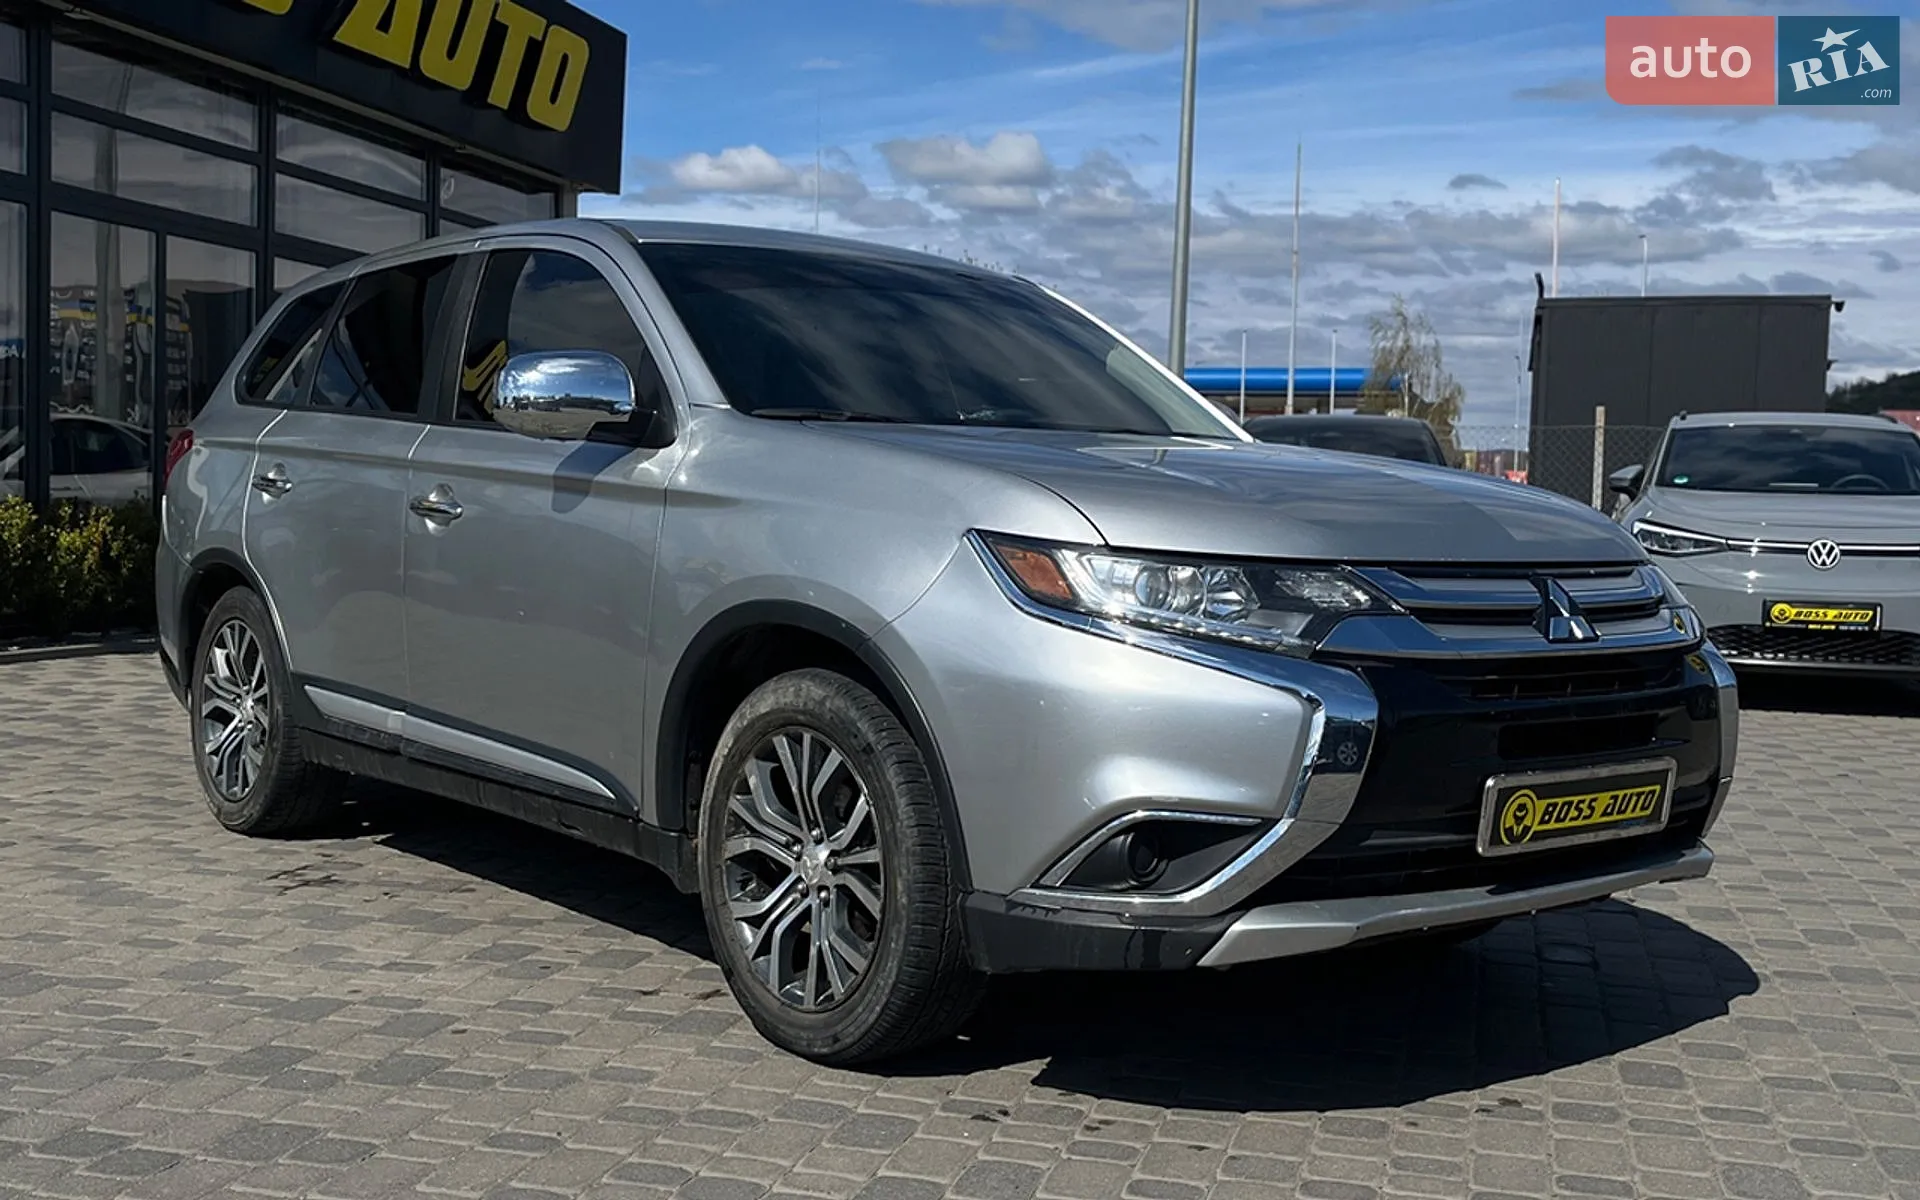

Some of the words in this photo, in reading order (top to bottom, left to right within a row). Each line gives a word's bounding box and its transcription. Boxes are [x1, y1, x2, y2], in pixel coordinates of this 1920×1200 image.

[333, 0, 590, 132] AUTO
[1793, 609, 1828, 619] BOSS
[1832, 610, 1870, 620] AUTO
[1538, 797, 1599, 825] BOSS
[1601, 789, 1654, 817] AUTO
